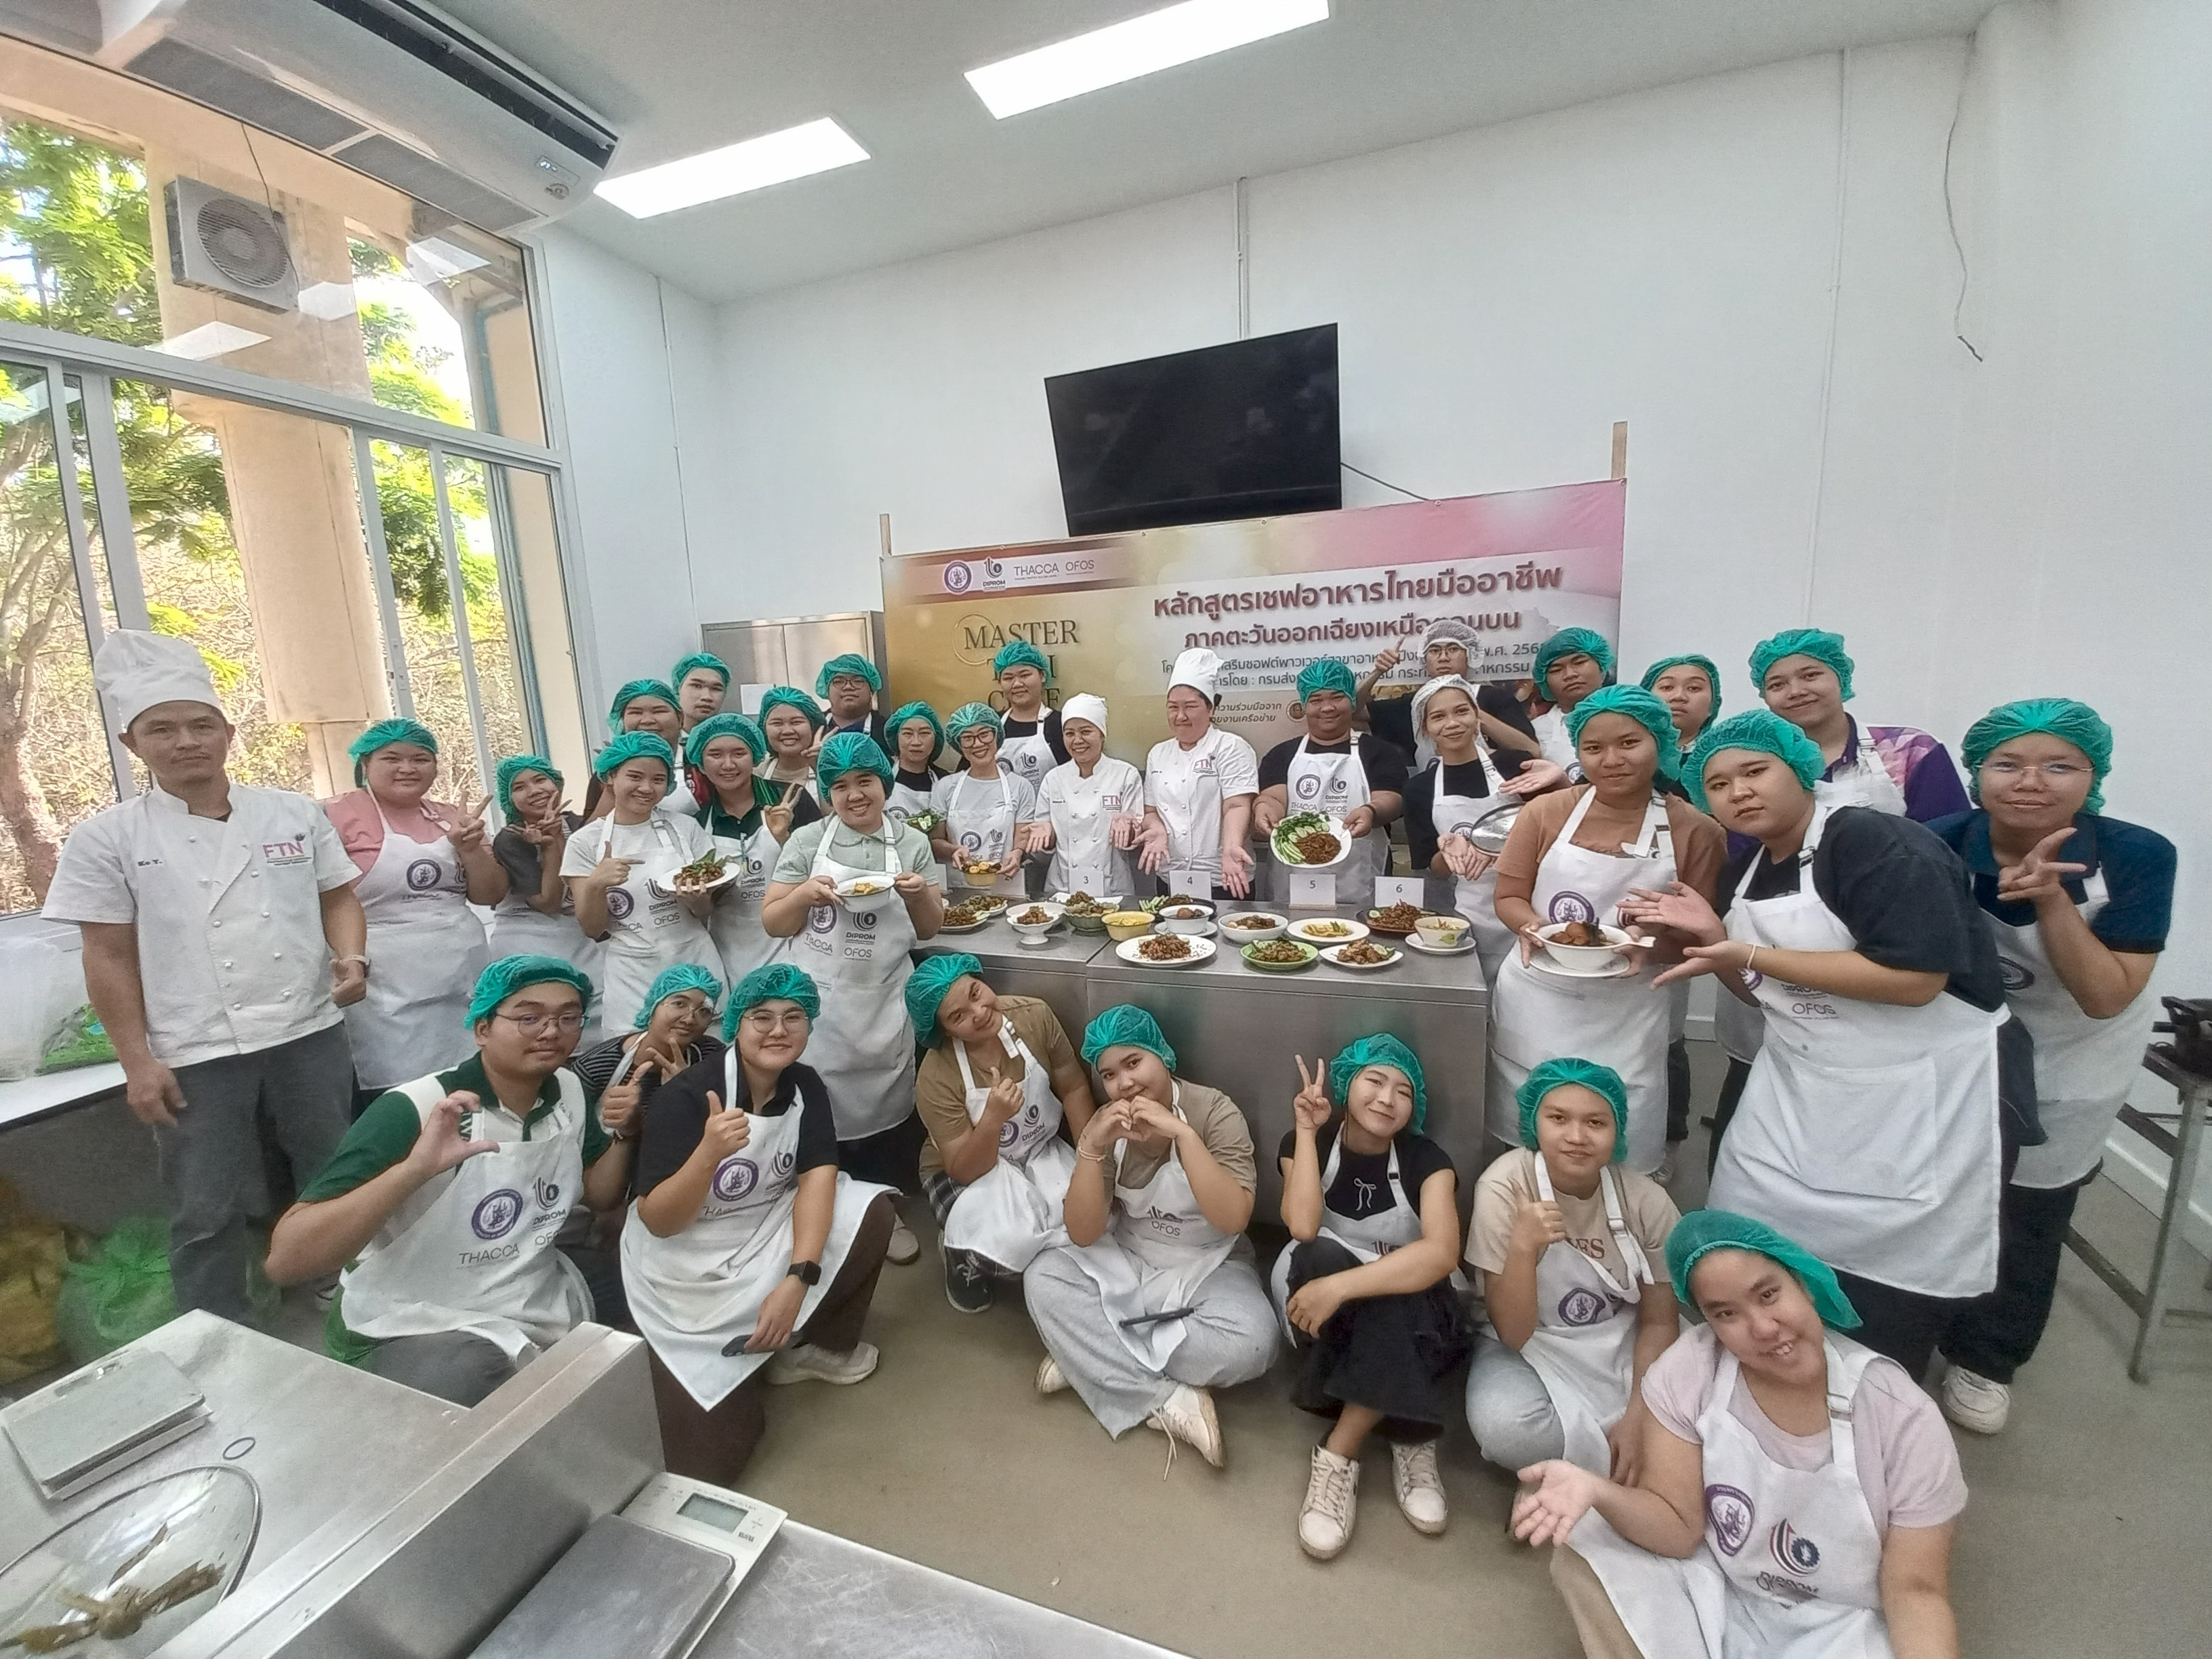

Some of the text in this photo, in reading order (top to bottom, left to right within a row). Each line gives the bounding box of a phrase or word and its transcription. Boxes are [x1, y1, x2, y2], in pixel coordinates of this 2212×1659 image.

[1014, 560, 1094, 576] THACCA OFOS
[1154, 561, 1561, 620] หลักสูตรเชฟอาหารไทยมืออาชีพ
[964, 619, 1079, 650] MASTER
[1512, 642, 1540, 655] 256
[1101, 795, 1121, 804] FTN
[263, 842, 304, 858] FTN
[1084, 876, 1089, 884] 3
[1187, 876, 1193, 885] 4
[1309, 880, 1316, 889] 5
[741, 890, 766, 899] OFOS
[1395, 884, 1403, 893] 6
[649, 899, 678, 911] DIPROM
[653, 912, 680, 926] OFOS
[846, 932, 876, 941] DIPROM
[844, 947, 873, 958] OFOS
[1792, 1003, 1837, 1015] OFOS
[1151, 1221, 1181, 1236] OFOS
[459, 1243, 520, 1265] THACCA
